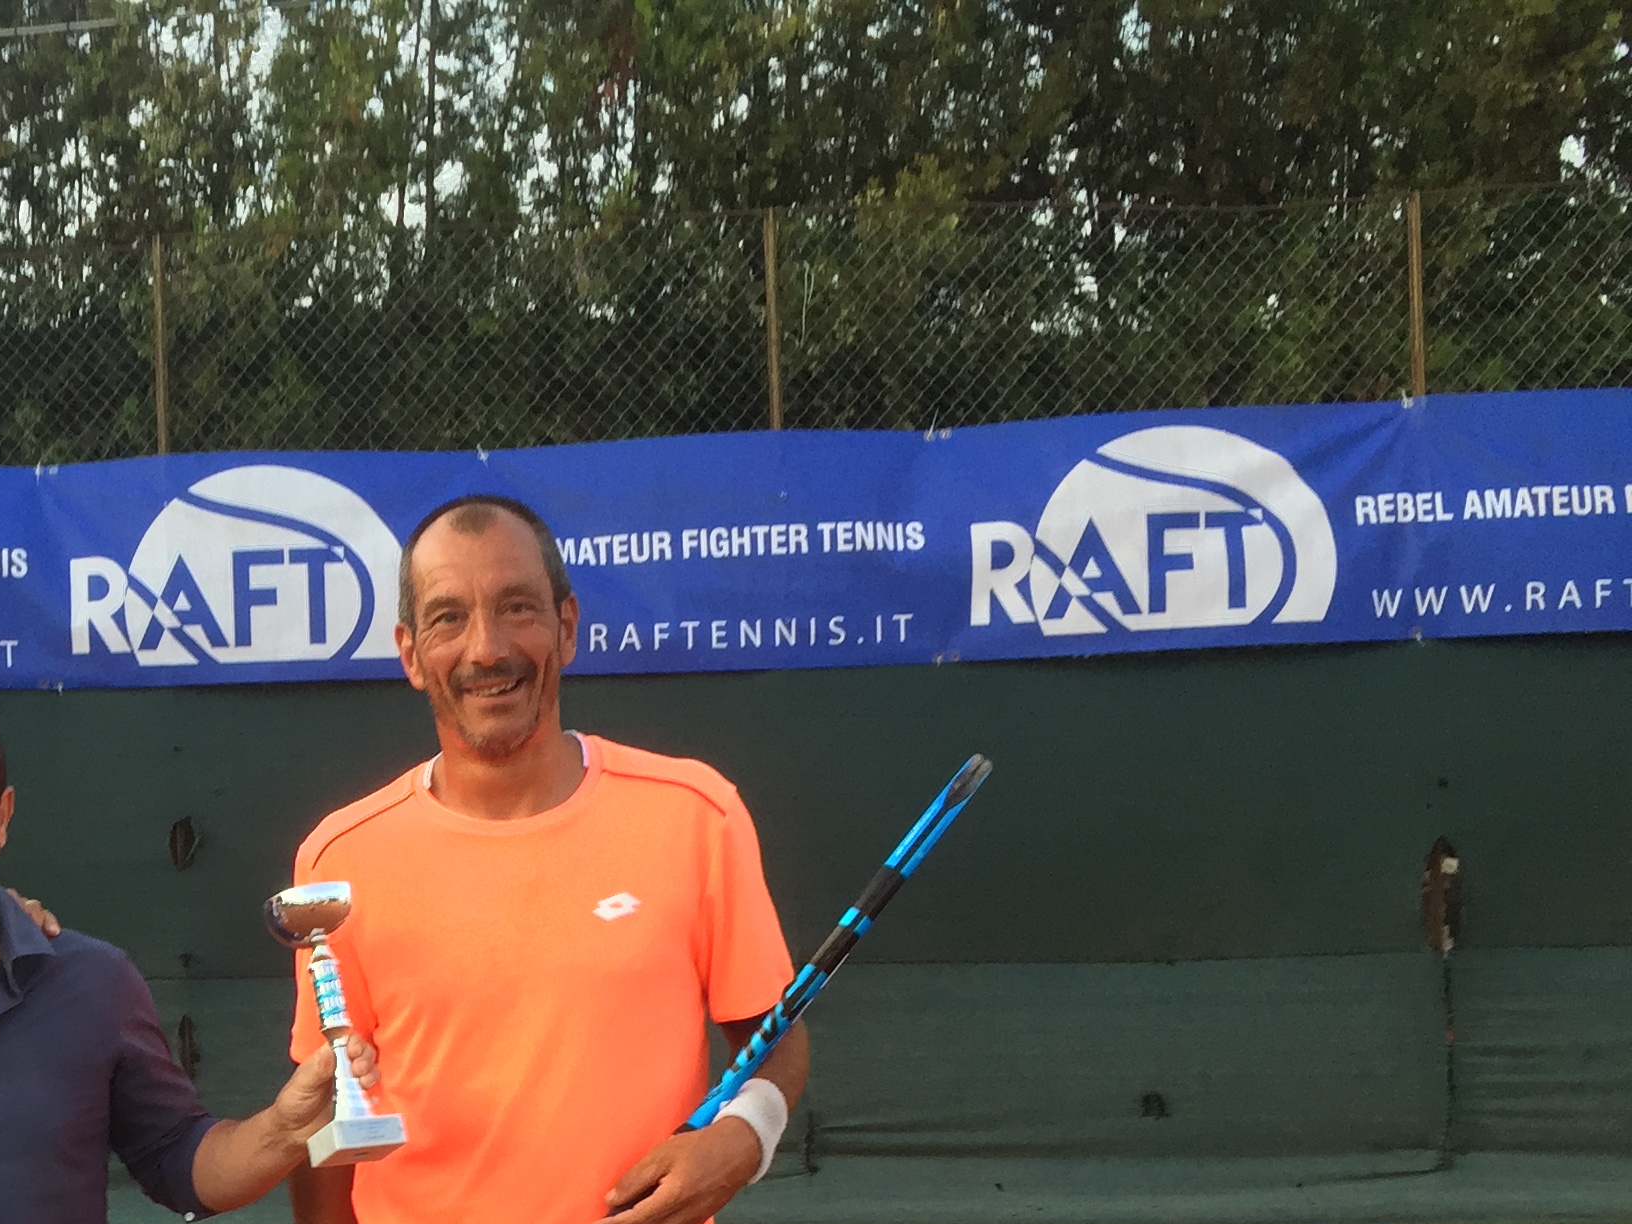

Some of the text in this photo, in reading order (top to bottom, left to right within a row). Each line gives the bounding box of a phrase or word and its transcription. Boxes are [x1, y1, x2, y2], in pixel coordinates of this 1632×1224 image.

[1355, 491, 1454, 526] REBEL
[1463, 485, 1616, 520] AMATEUR
[555, 521, 926, 566] MATEUR FIGHTER TENNIS
[970, 508, 1263, 626] RAFT
[69, 545, 346, 656] RAFT
[589, 613, 913, 653] RAFTENNIS.IT
